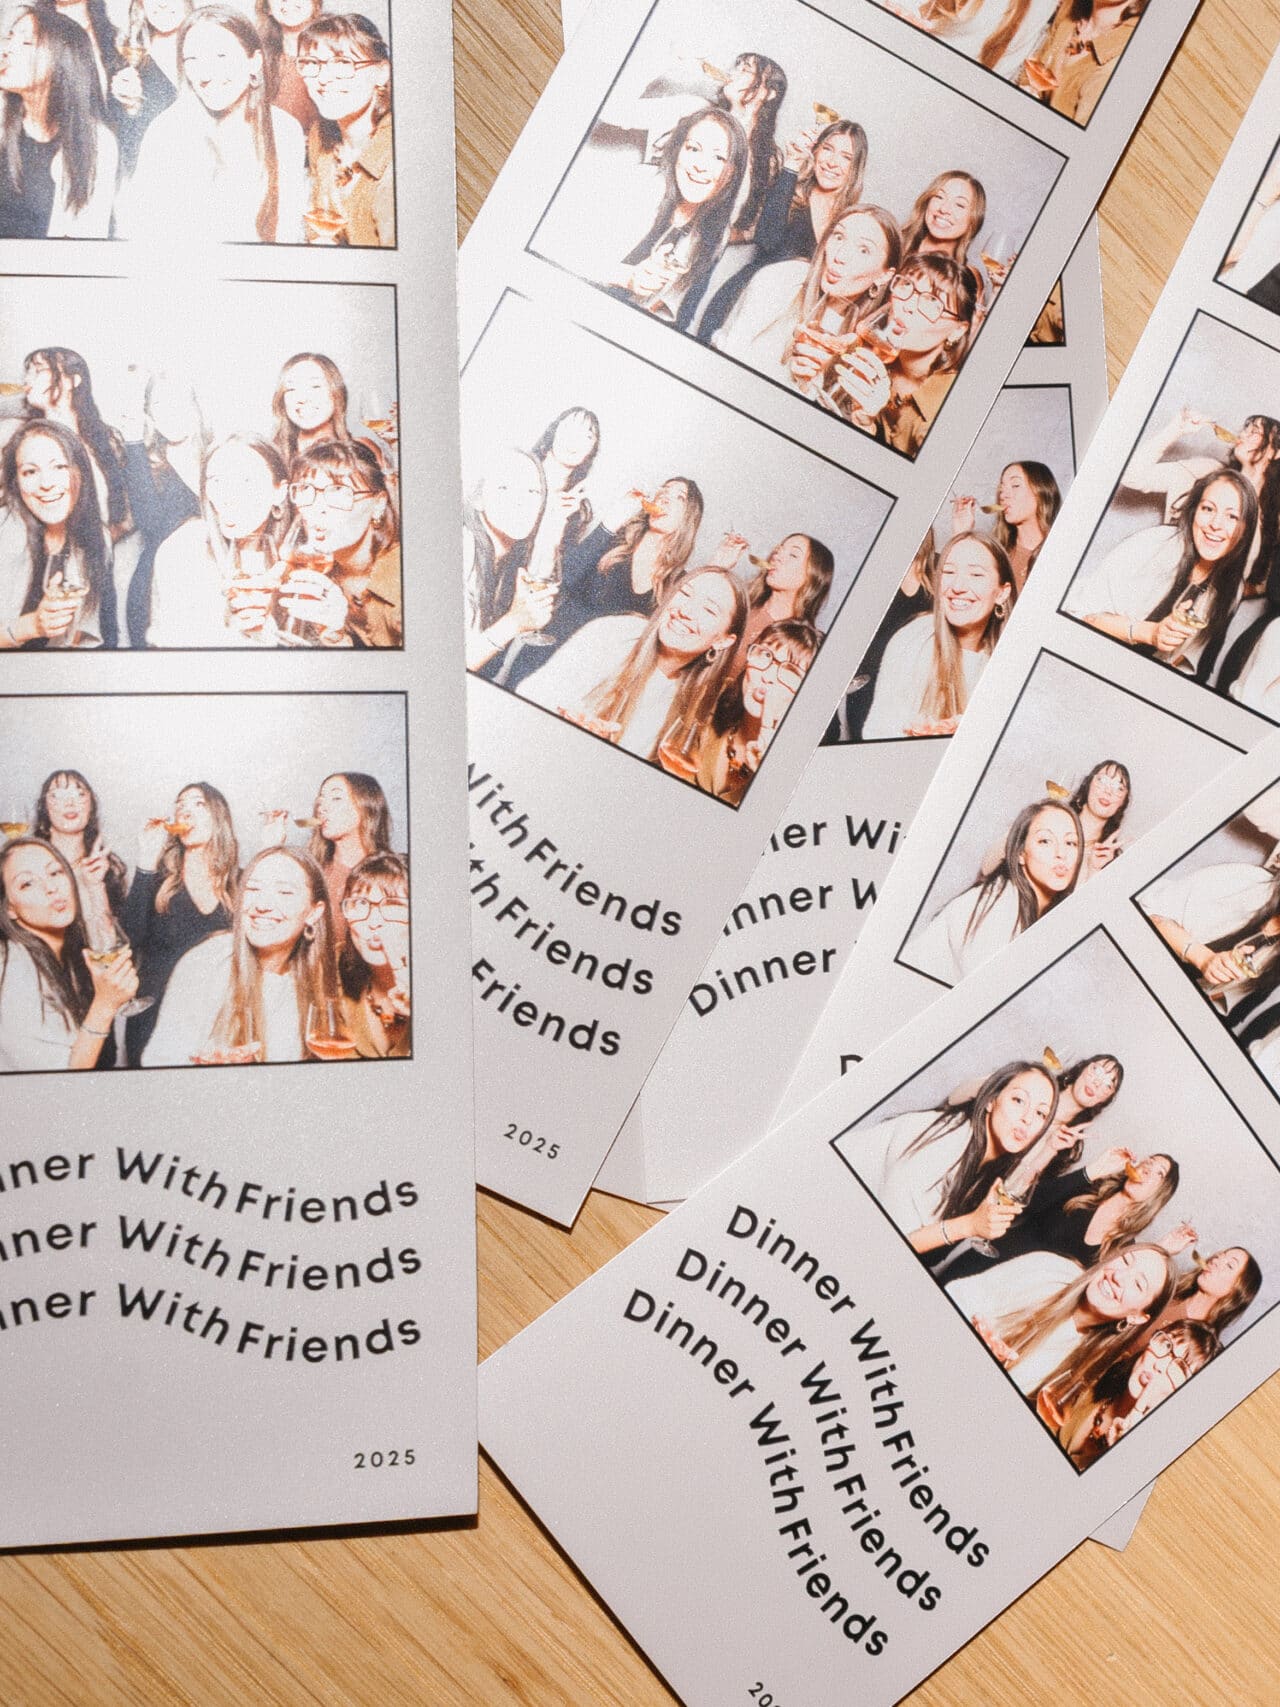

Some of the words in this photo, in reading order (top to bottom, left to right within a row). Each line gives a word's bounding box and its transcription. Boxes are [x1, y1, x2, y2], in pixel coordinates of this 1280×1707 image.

[844, 814, 903, 855] Wi
[523, 837, 683, 937] Friends
[494, 895, 654, 996] Friends
[687, 947, 837, 1018] Dinner
[471, 957, 621, 1057] Friends
[503, 1123, 561, 1160] 2025
[0, 1153, 96, 1194] ner
[116, 1146, 229, 1210] With
[234, 1179, 419, 1224] Friends
[0, 1221, 98, 1262] ner
[118, 1214, 231, 1279] With
[237, 1246, 422, 1292] Friends
[0, 1290, 97, 1331] ner
[117, 1282, 230, 1346] With
[236, 1317, 422, 1364] Friends
[725, 1204, 857, 1315] Dinner
[849, 1317, 905, 1430] With
[881, 1429, 990, 1568] Friends
[353, 1448, 416, 1470] 2025
[675, 1247, 808, 1358] Dinner
[799, 1359, 857, 1473] With
[832, 1472, 942, 1612] Friends
[622, 1287, 756, 1399] Dinner
[748, 1400, 805, 1515] With
[778, 1517, 889, 1657] Friends
[747, 1681, 781, 1707] 20
